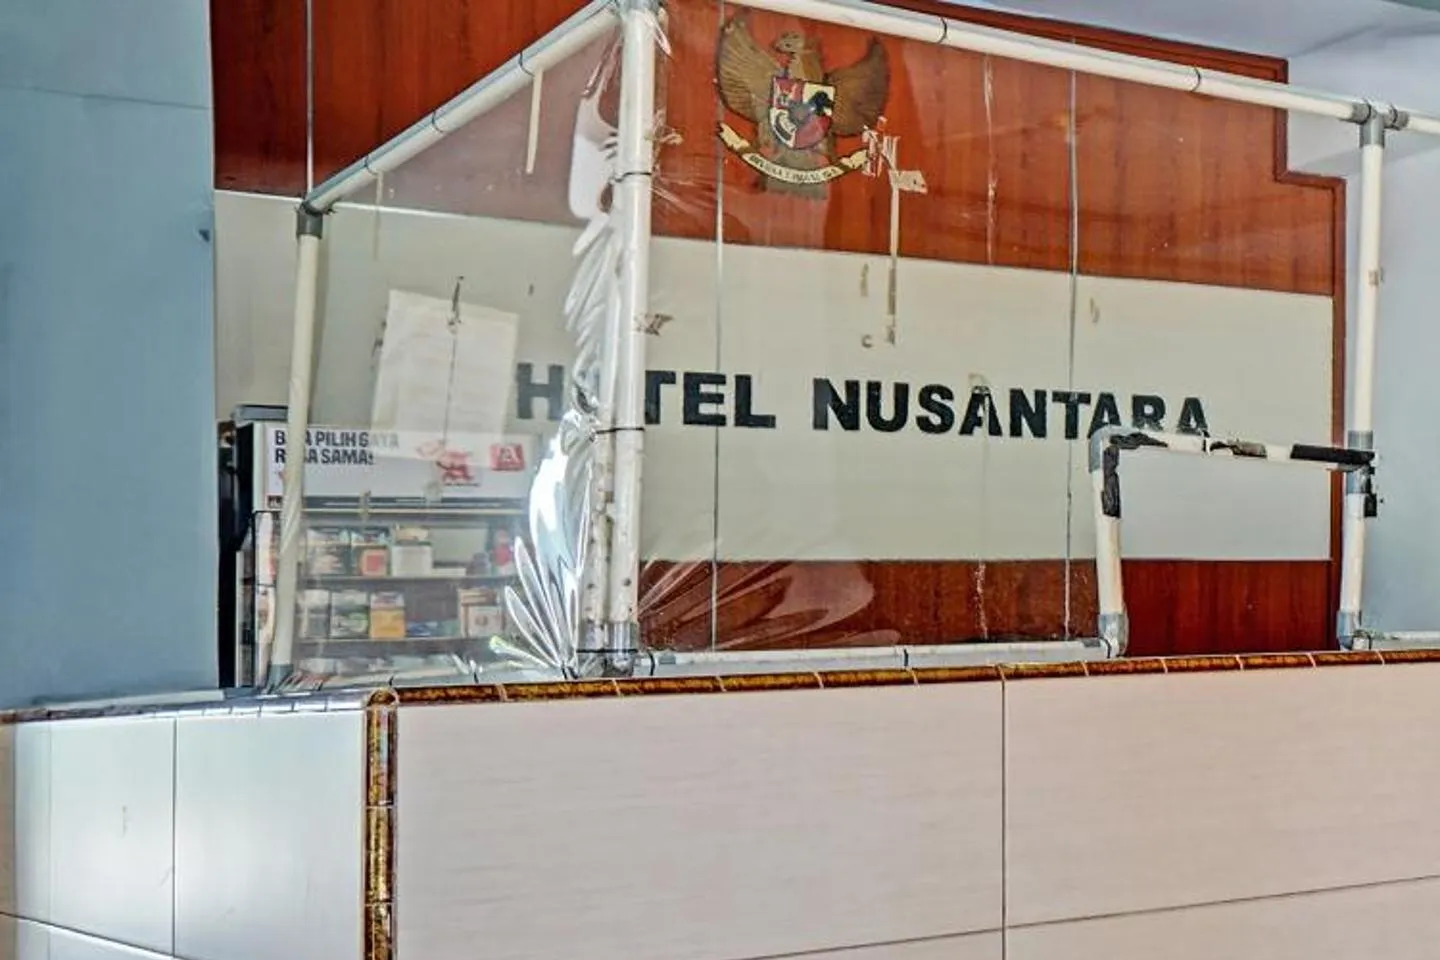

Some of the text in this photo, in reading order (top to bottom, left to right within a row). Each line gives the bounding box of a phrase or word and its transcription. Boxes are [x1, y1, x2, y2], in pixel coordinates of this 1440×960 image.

[516, 362, 1210, 440] HTEL NUSANTARA
[275, 429, 312, 447] BA
[315, 430, 357, 447] PILIH
[275, 448, 318, 464] RA
